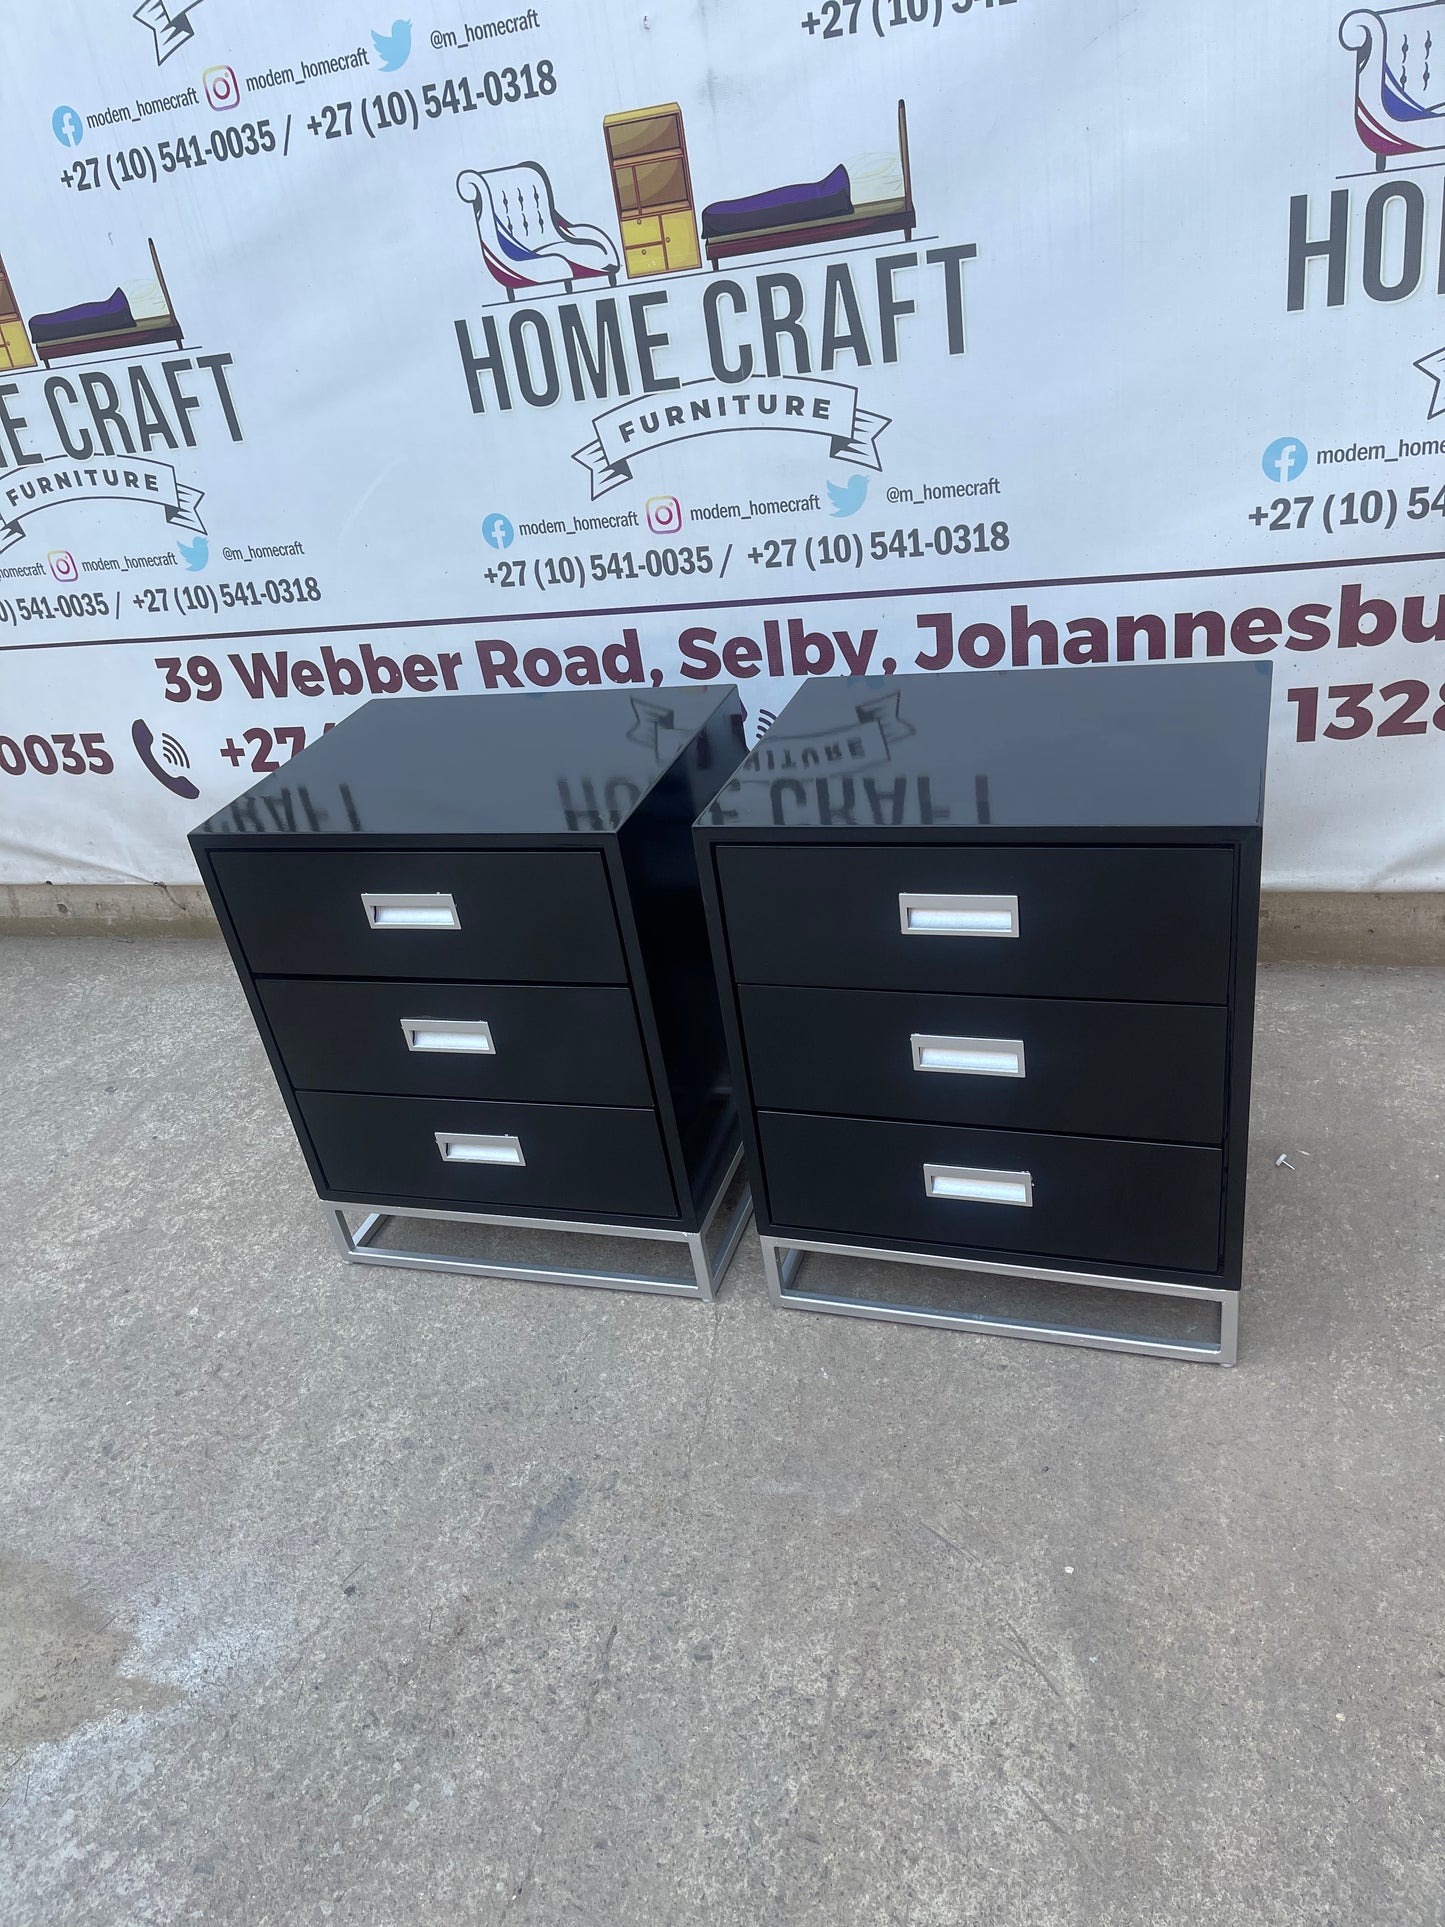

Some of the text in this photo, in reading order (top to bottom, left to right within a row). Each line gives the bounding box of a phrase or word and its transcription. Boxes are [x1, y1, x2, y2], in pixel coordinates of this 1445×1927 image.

[431, 9, 540, 49] @m_homecraft
[801, 0, 861, 39] +27
[61, 60, 557, 191] +27 (10) 541-0035 / +27 (10) 541-0318
[1287, 176, 1445, 312] HO
[454, 243, 977, 413] HOME CRAFT
[0, 353, 243, 468] E CRAFT
[619, 394, 830, 442] FURNITURE
[6, 469, 158, 506] FURNITURE
[887, 477, 1000, 504] @m_homecraft
[1249, 496, 1314, 531] +27
[1323, 489, 1397, 533] (10)
[223, 541, 305, 562] @m_homecraft
[484, 521, 1009, 591] +27 (10) 541-0035 / +27 (10) 541-0318
[16, 593, 109, 620] 541-0035
[116, 591, 120, 619] /
[133, 588, 168, 612] +27
[174, 585, 218, 615] (10)
[219, 577, 321, 607] 541-0318
[154, 656, 222, 702] 39
[227, 644, 462, 699] Webber
[475, 629, 663, 689] Road,
[679, 619, 896, 677] Selby,
[1288, 680, 1445, 742] 132
